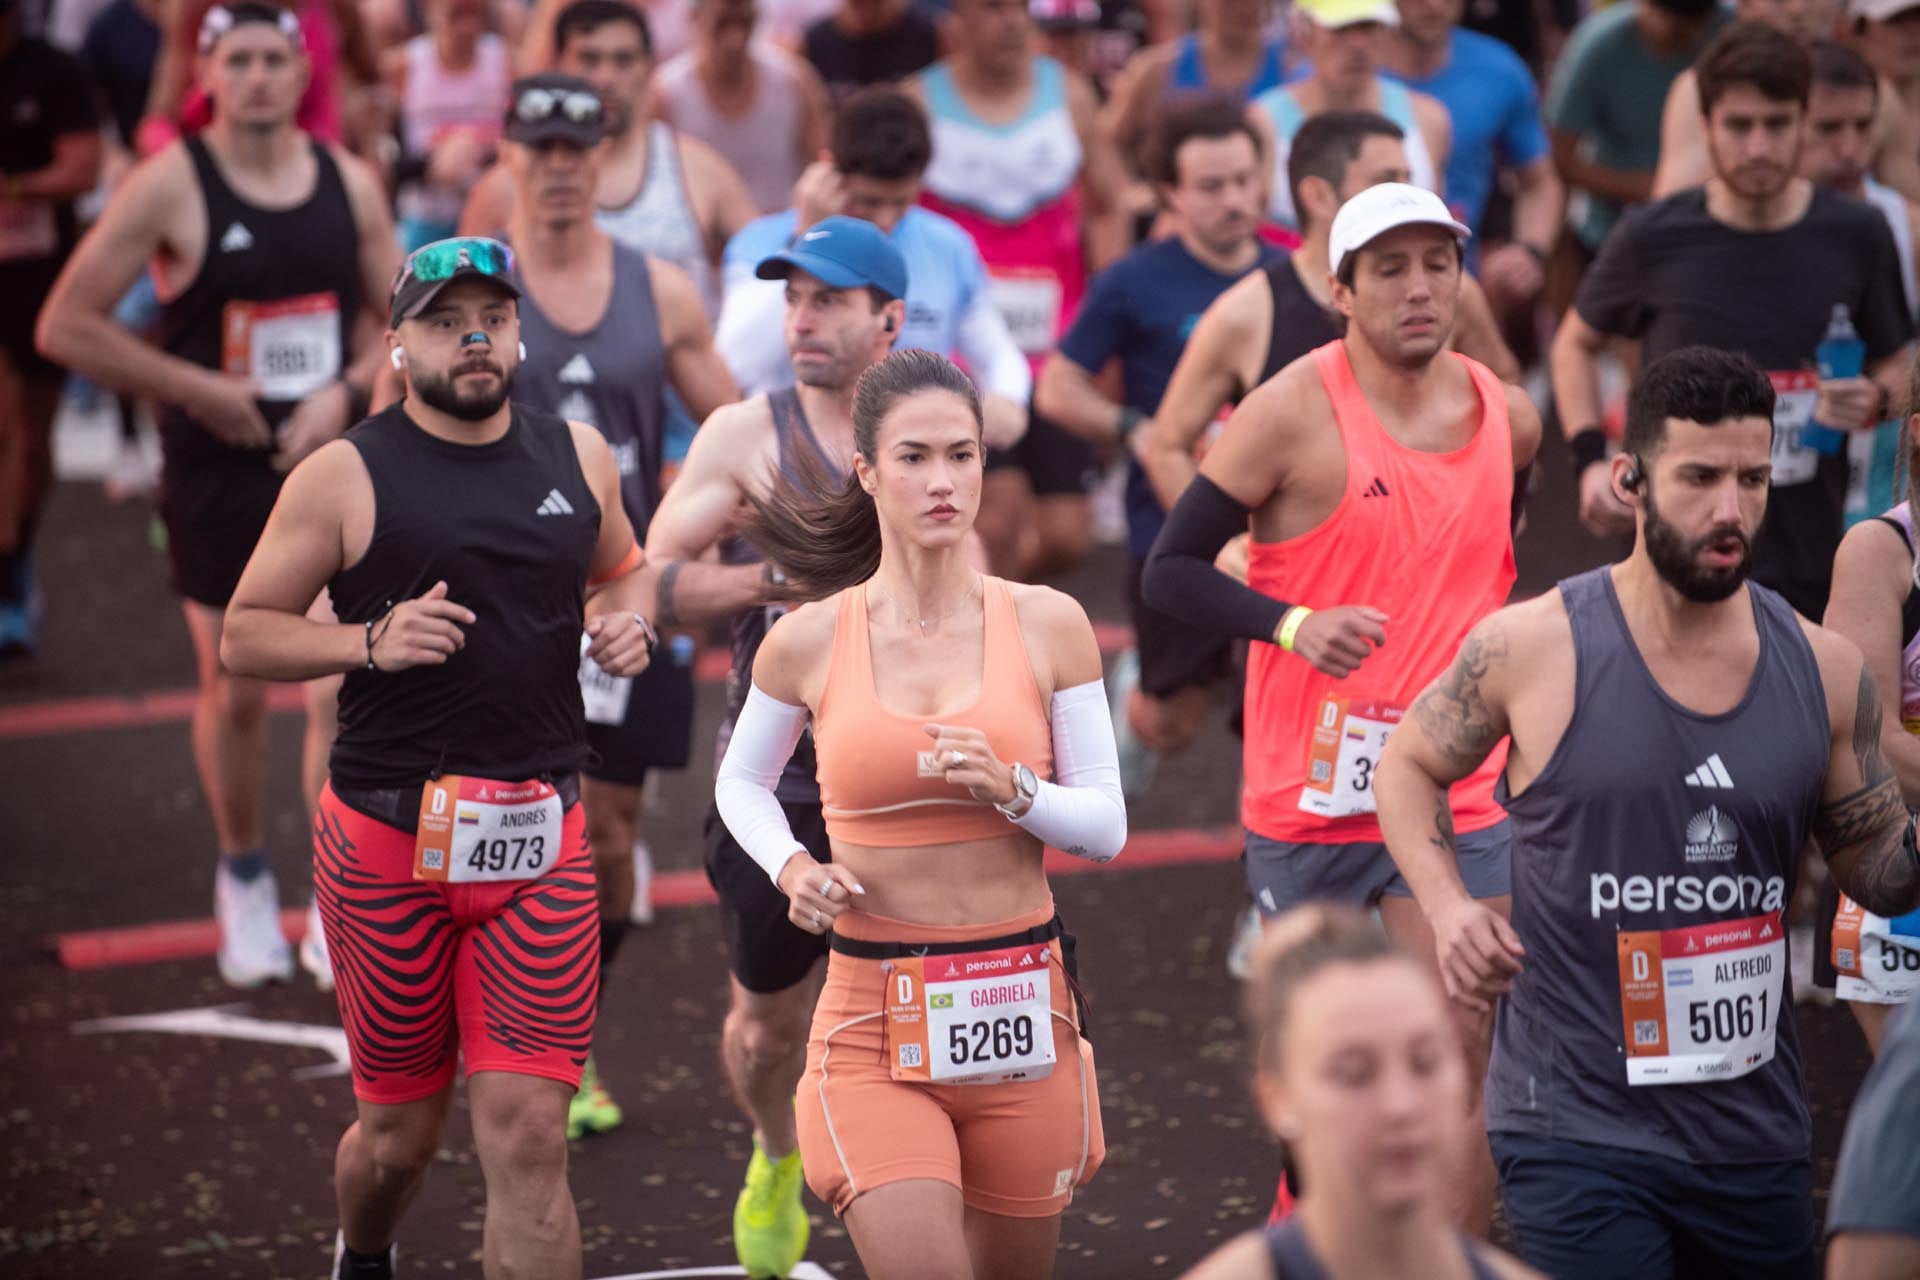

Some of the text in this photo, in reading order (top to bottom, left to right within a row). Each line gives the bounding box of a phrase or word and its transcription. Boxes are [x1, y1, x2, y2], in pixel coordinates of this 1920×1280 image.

[1323, 701, 1339, 729] D
[431, 787, 447, 815] D
[495, 787, 536, 800] personal
[499, 808, 547, 828] ANDRÉS
[467, 836, 545, 872] 4973
[1705, 930, 1752, 948] personal
[966, 957, 1012, 974] personal
[1632, 950, 1649, 981] D
[1715, 954, 1772, 984] ALFREDO
[897, 974, 913, 1004] D
[970, 982, 1036, 1008] GABRIELA
[1689, 988, 1768, 1044] 5061
[949, 1015, 1034, 1065] 5269
